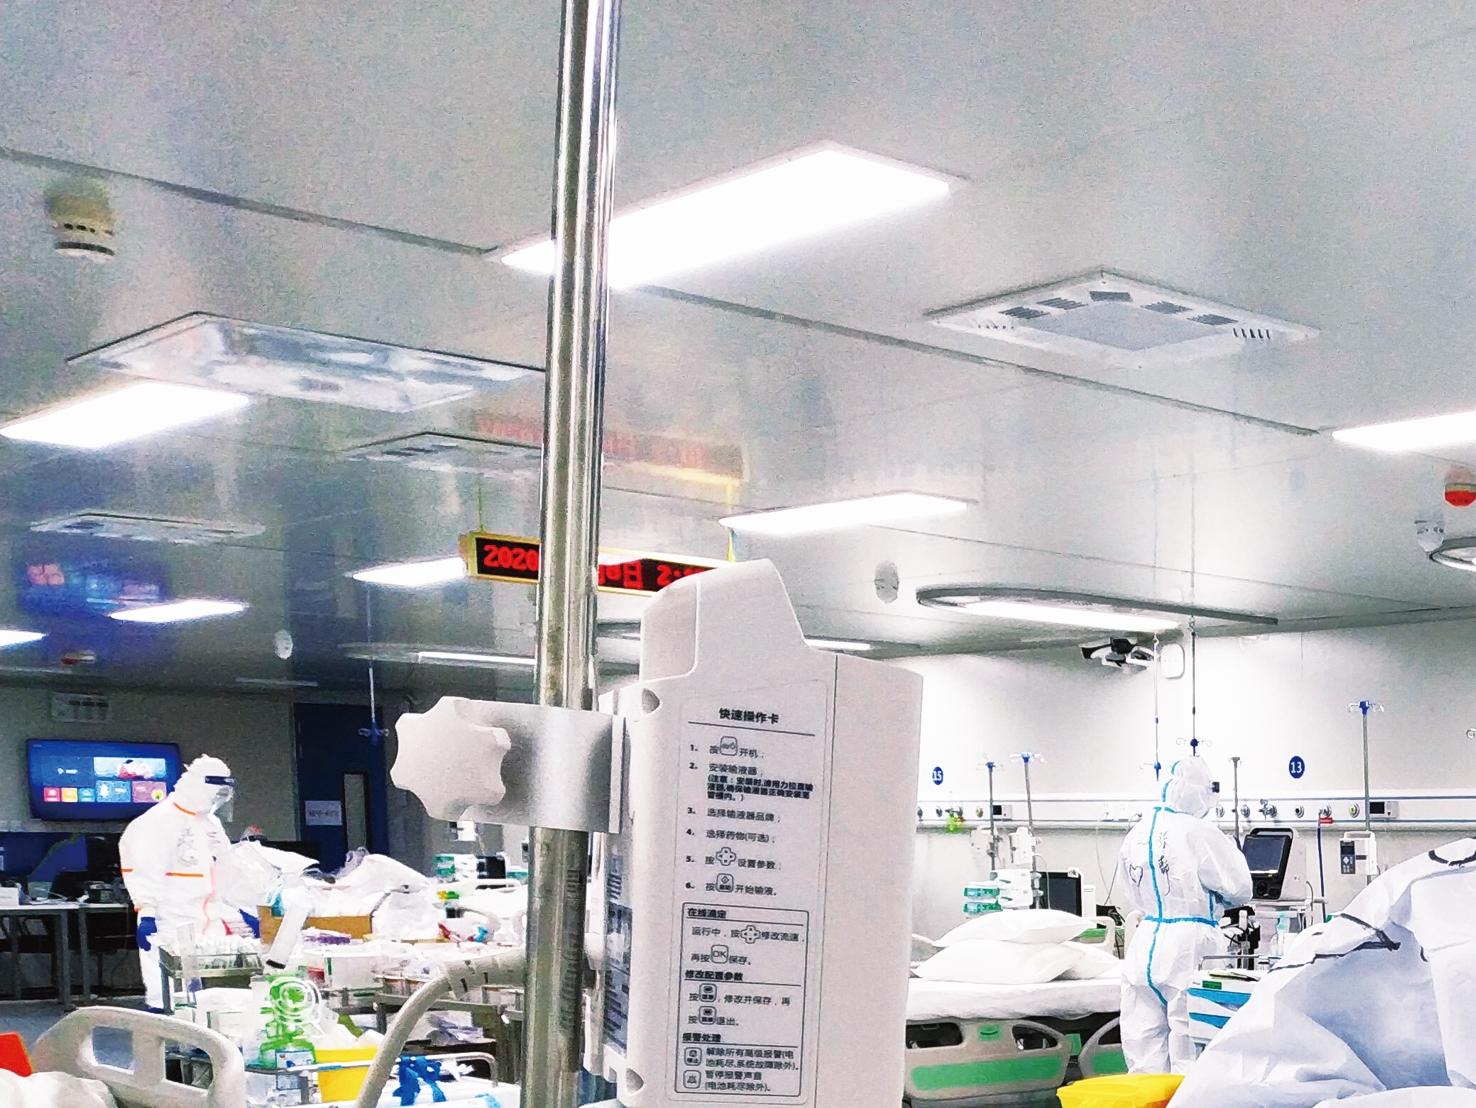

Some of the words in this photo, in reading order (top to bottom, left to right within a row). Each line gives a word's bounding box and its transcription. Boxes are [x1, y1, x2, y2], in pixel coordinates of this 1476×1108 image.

[484, 544, 539, 571] 2020
[719, 708, 779, 724] 快速操作卡
[689, 762, 698, 770] 2.
[686, 828, 695, 836] 4.
[713, 950, 727, 958] OK
